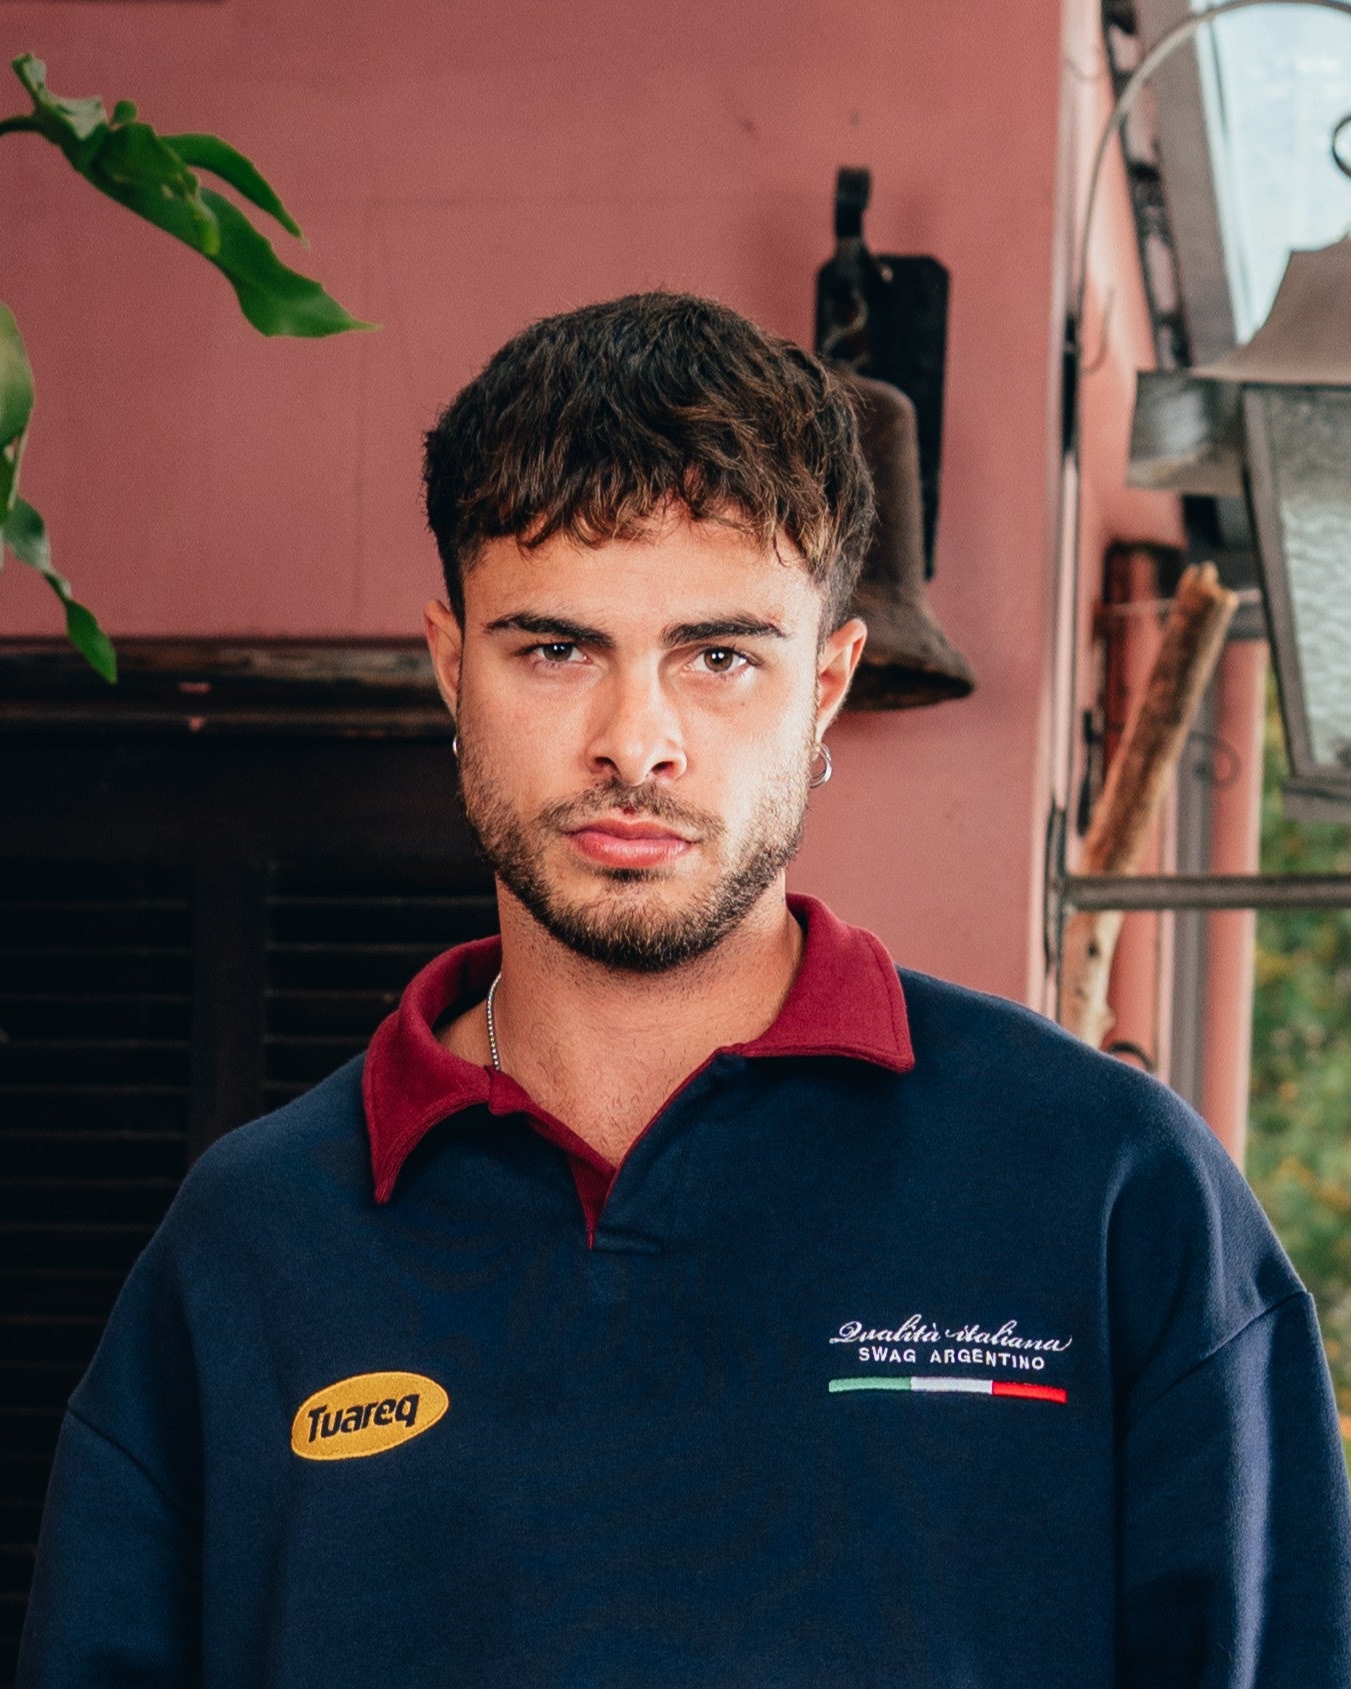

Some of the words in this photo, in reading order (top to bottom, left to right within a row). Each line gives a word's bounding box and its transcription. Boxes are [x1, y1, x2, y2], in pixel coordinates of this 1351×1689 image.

[829, 1313, 941, 1344] Qualità
[945, 1319, 1073, 1352] italiana
[858, 1346, 916, 1363] SWAG
[929, 1348, 1045, 1370] ARGENTINO
